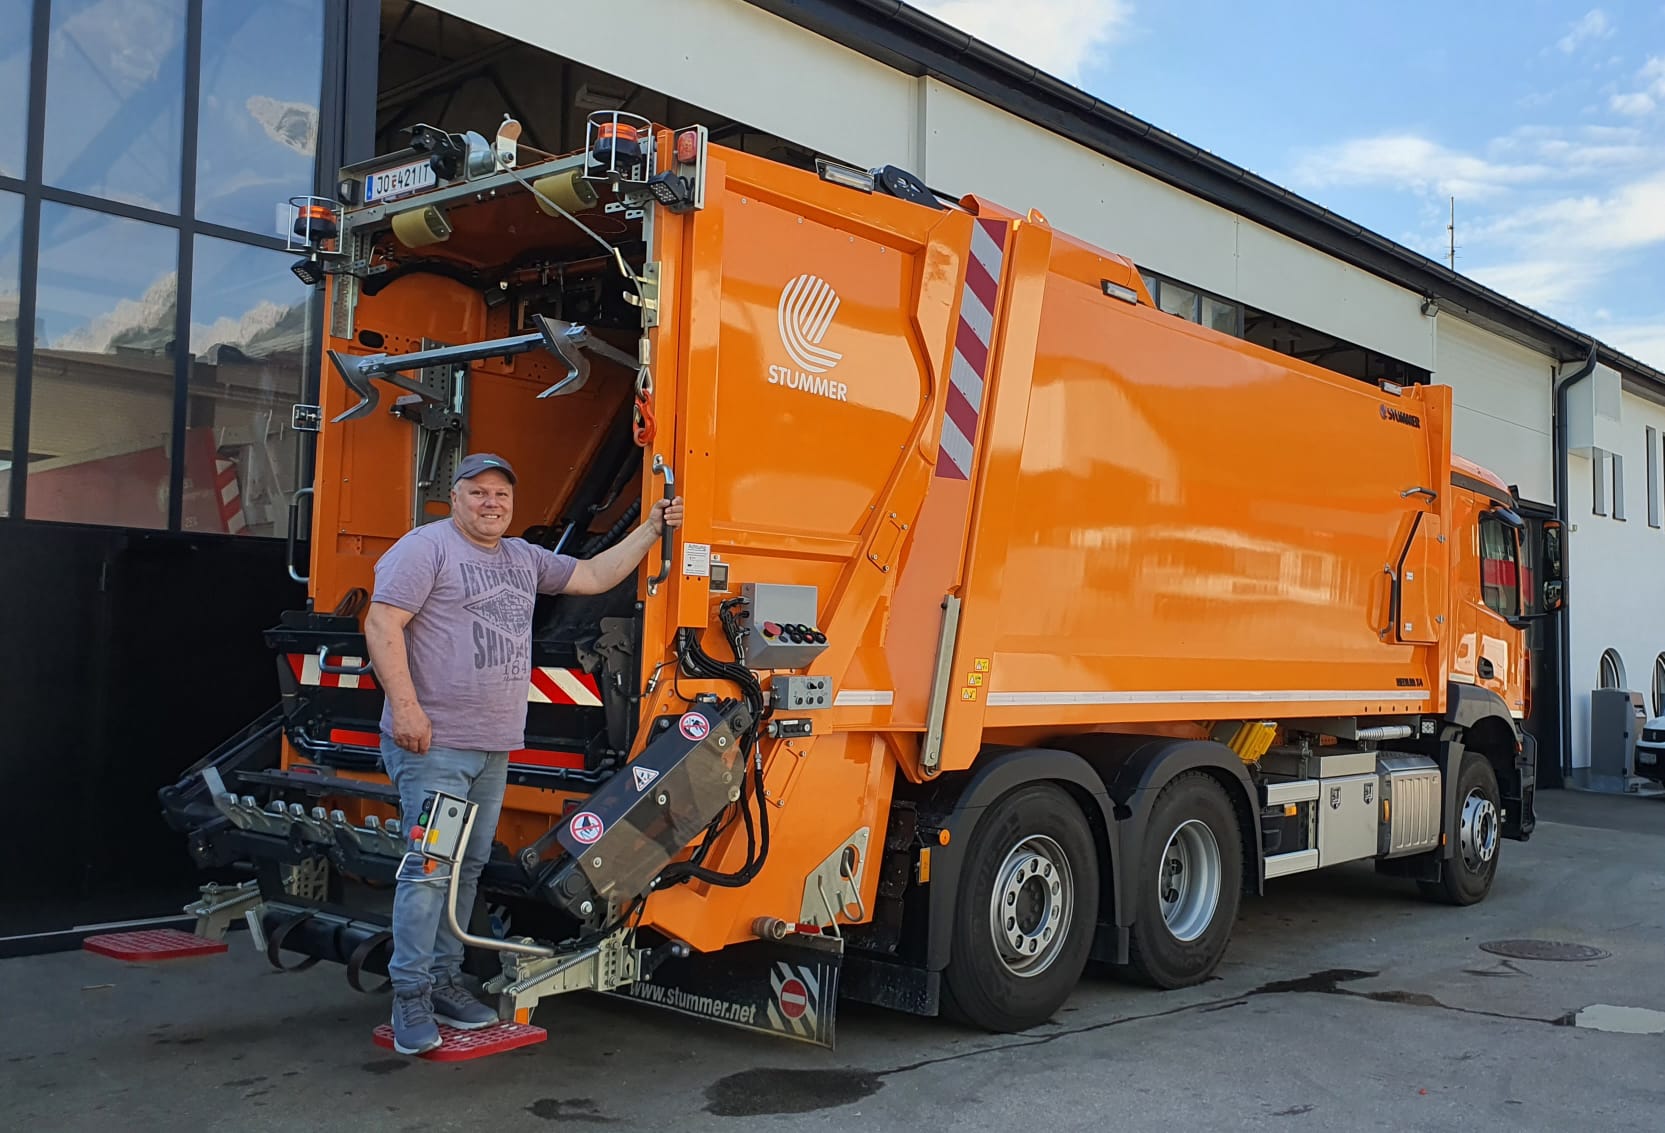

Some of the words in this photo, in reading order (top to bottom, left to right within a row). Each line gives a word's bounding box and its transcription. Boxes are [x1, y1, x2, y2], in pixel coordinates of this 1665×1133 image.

[377, 175, 389, 193] JO
[767, 364, 847, 402] STUMMER
[630, 981, 756, 1024] www.stummer.net
